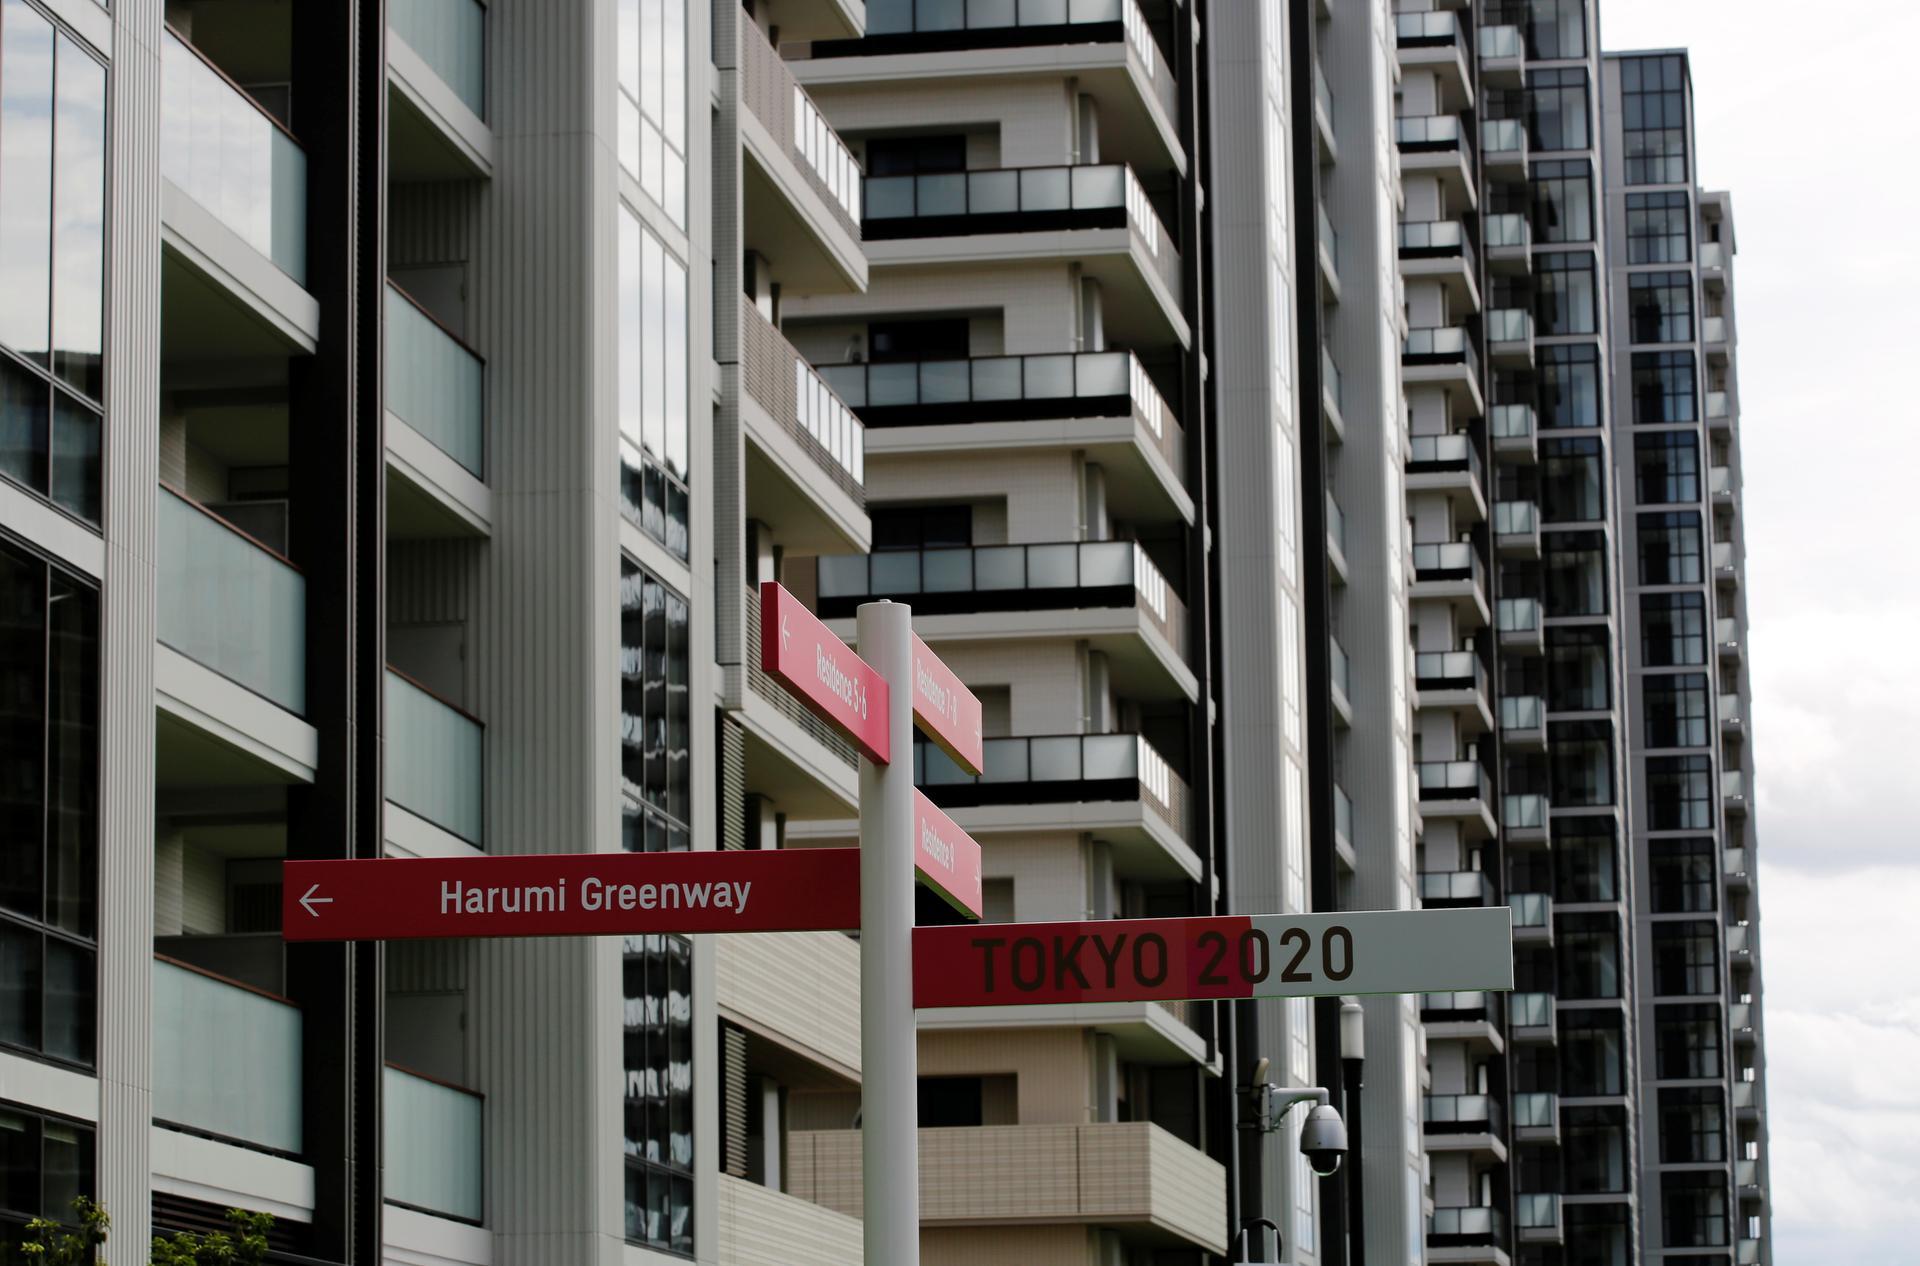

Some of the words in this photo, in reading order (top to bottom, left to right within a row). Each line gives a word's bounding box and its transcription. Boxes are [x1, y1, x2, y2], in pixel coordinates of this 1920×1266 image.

[816, 642, 852, 707] Residence
[916, 657, 945, 715] Residence
[921, 816, 950, 869] Residence
[440, 878, 566, 914] Harumi
[581, 877, 752, 914] Greenway
[971, 932, 1168, 993] TOKYO
[1197, 925, 1354, 985] 2020
